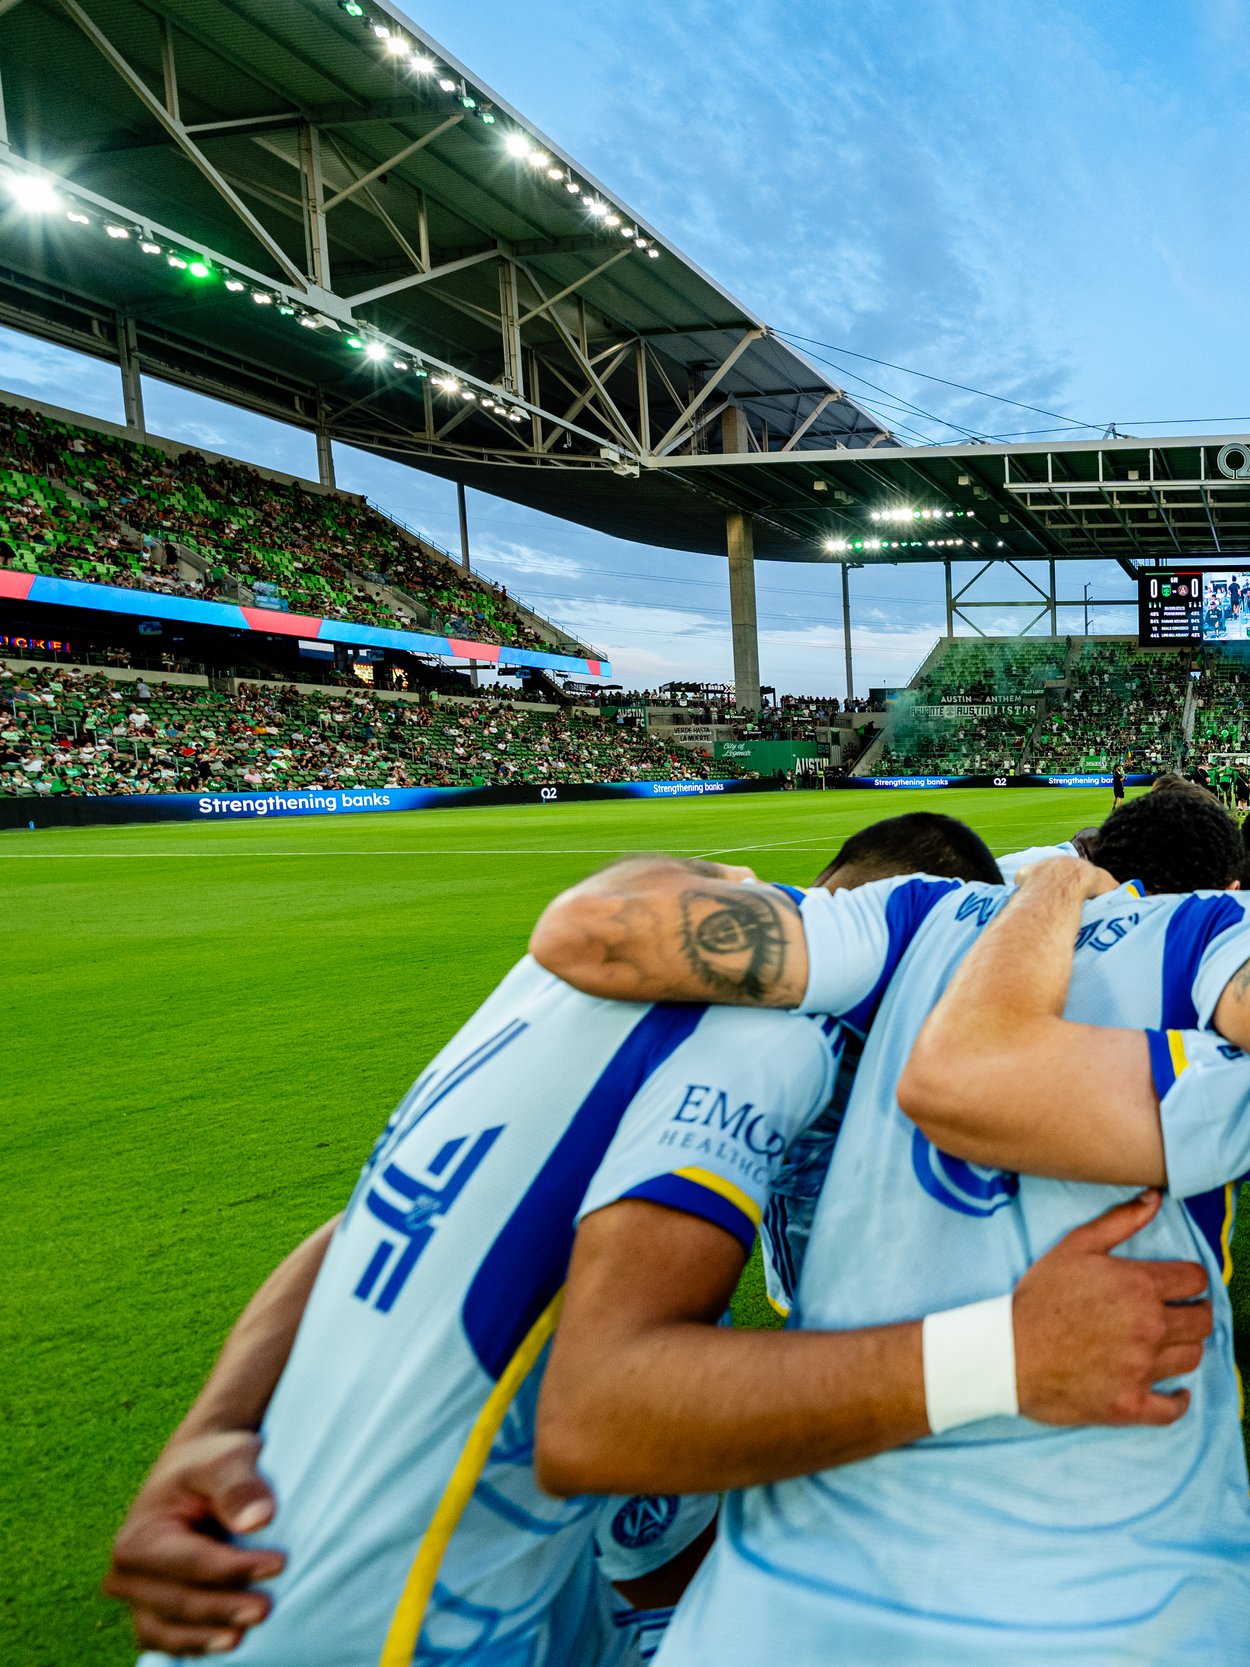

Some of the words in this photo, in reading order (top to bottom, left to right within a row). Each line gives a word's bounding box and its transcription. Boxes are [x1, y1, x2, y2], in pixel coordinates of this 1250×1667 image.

[1150, 579, 1158, 598] 0
[1191, 578, 1199, 597] 0
[941, 695, 972, 703] AUSTIN
[985, 695, 1022, 703] ANTHEM
[956, 706, 991, 716] AUSTIN
[636, 719, 645, 727] FC
[723, 743, 737, 751] City
[874, 778, 925, 787] Strengthening
[993, 777, 1007, 786] Q2
[1048, 777, 1099, 786] Strengthening
[653, 782, 704, 794] Strengthening
[704, 782, 724, 791] banks
[540, 787, 558, 799] Q2
[199, 793, 337, 815] Strengthening
[341, 792, 391, 807] banks
